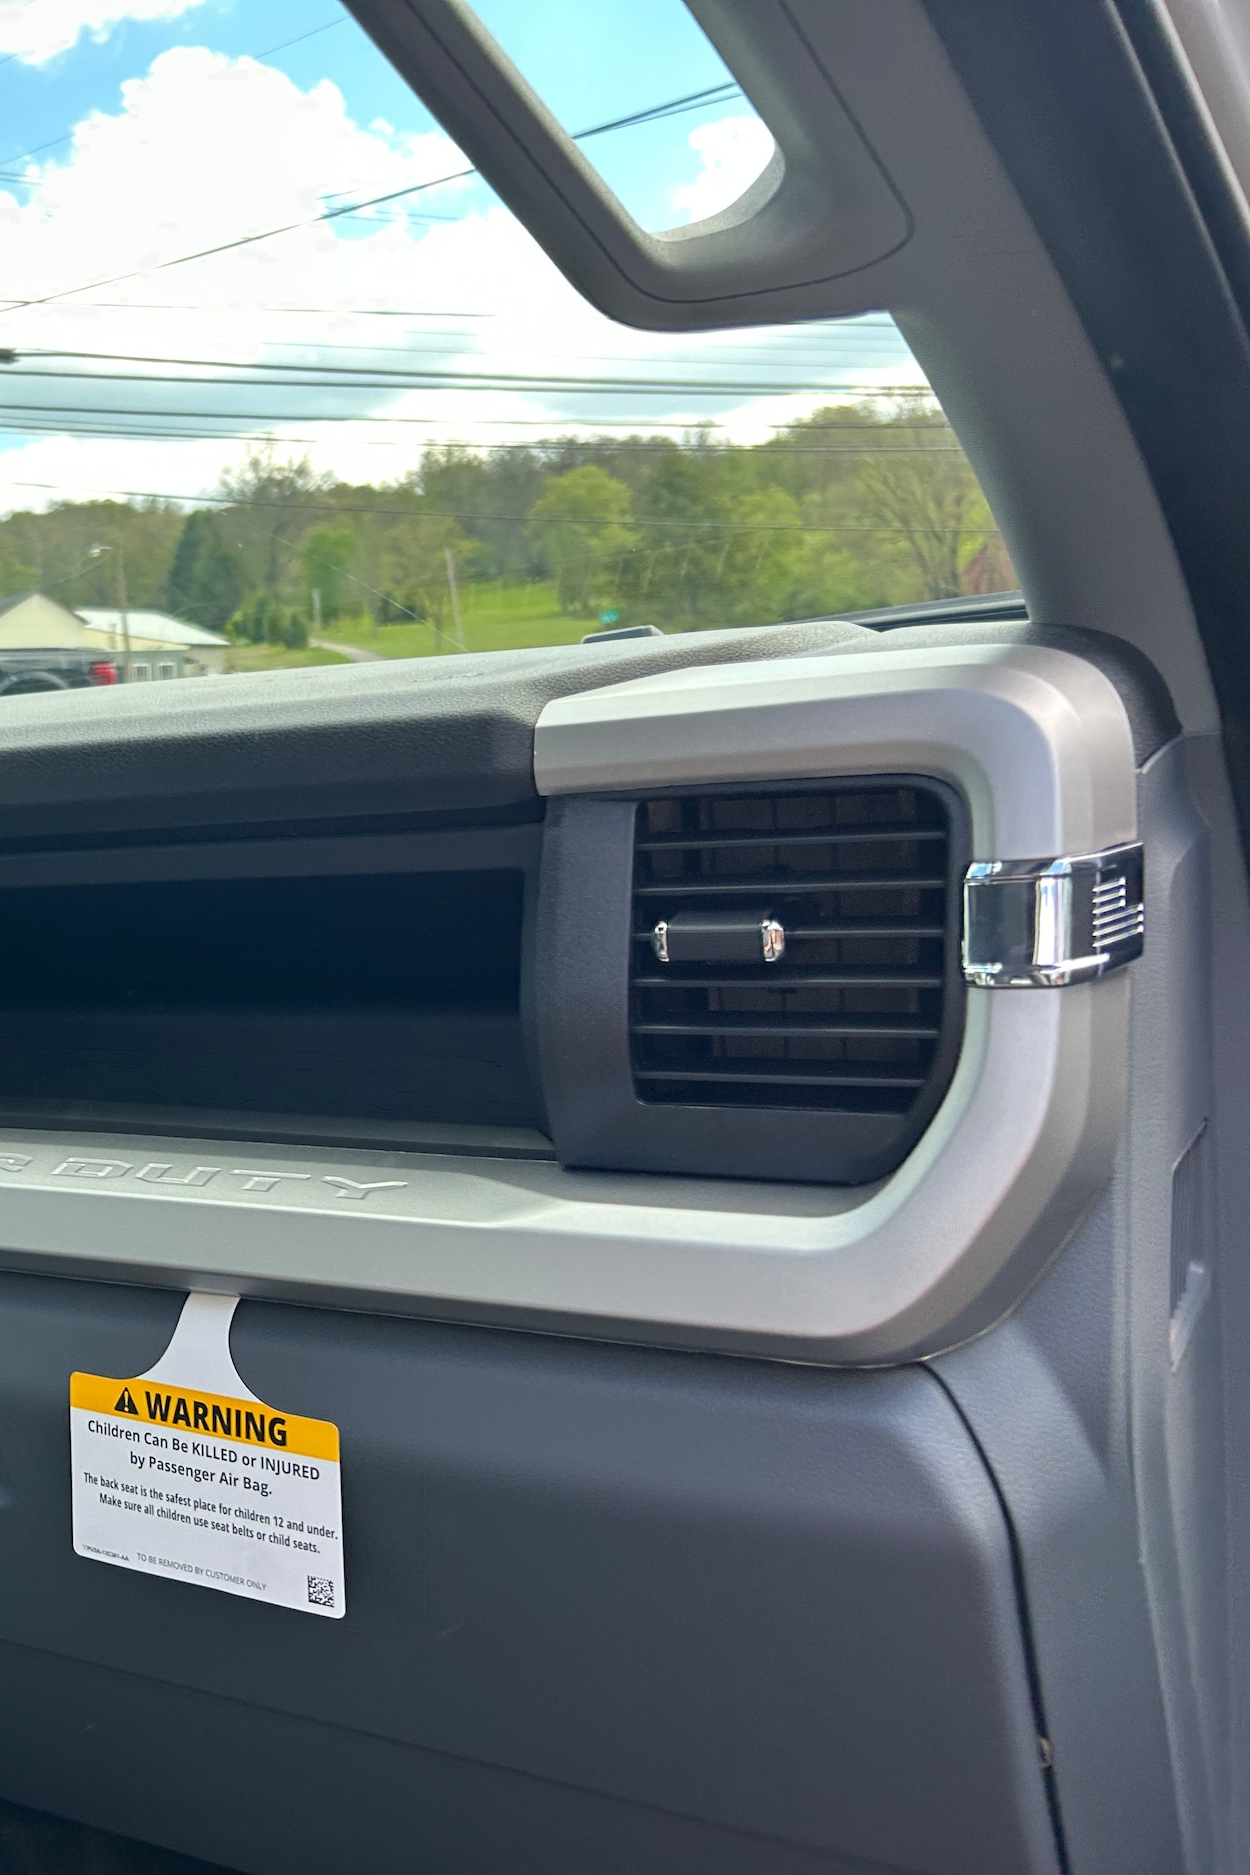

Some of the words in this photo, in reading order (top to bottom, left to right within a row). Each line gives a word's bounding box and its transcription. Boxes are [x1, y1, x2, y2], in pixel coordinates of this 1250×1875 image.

[50, 1157, 408, 1199] DUTY
[146, 1390, 287, 1446] WARNING
[88, 1421, 140, 1443] Children
[144, 1433, 168, 1449] Can
[172, 1439, 188, 1453] Be
[192, 1442, 237, 1463] KILLED
[242, 1454, 256, 1466] or
[261, 1457, 320, 1480] INJURED
[130, 1452, 145, 1468] by
[150, 1459, 215, 1482] Passenger
[219, 1474, 239, 1485] Air
[244, 1478, 272, 1496] Bag.
[84, 1472, 98, 1485] The
[101, 1476, 118, 1489] back
[121, 1480, 138, 1493] seat
[141, 1484, 147, 1495] is
[150, 1487, 163, 1500] the
[166, 1491, 191, 1506] safest
[194, 1498, 216, 1514] place
[219, 1503, 231, 1516] for
[234, 1506, 270, 1524] children
[273, 1516, 283, 1527] 12
[286, 1518, 304, 1531] and
[307, 1522, 338, 1539] under.
[100, 1494, 121, 1506] Make
[124, 1500, 141, 1511] sure
[144, 1503, 154, 1516] all
[157, 1506, 191, 1524] children
[194, 1515, 208, 1526] use
[211, 1518, 229, 1532] seat
[232, 1523, 254, 1538] belts
[257, 1529, 266, 1540] or
[269, 1531, 290, 1546] child
[293, 1537, 320, 1554] seats.
[137, 1553, 146, 1562] TO
[148, 1554, 157, 1564] BE
[159, 1556, 193, 1572] REMOVED
[195, 1566, 204, 1575] BY
[206, 1568, 245, 1585] CUSTOMER
[247, 1578, 266, 1591] ONLY
